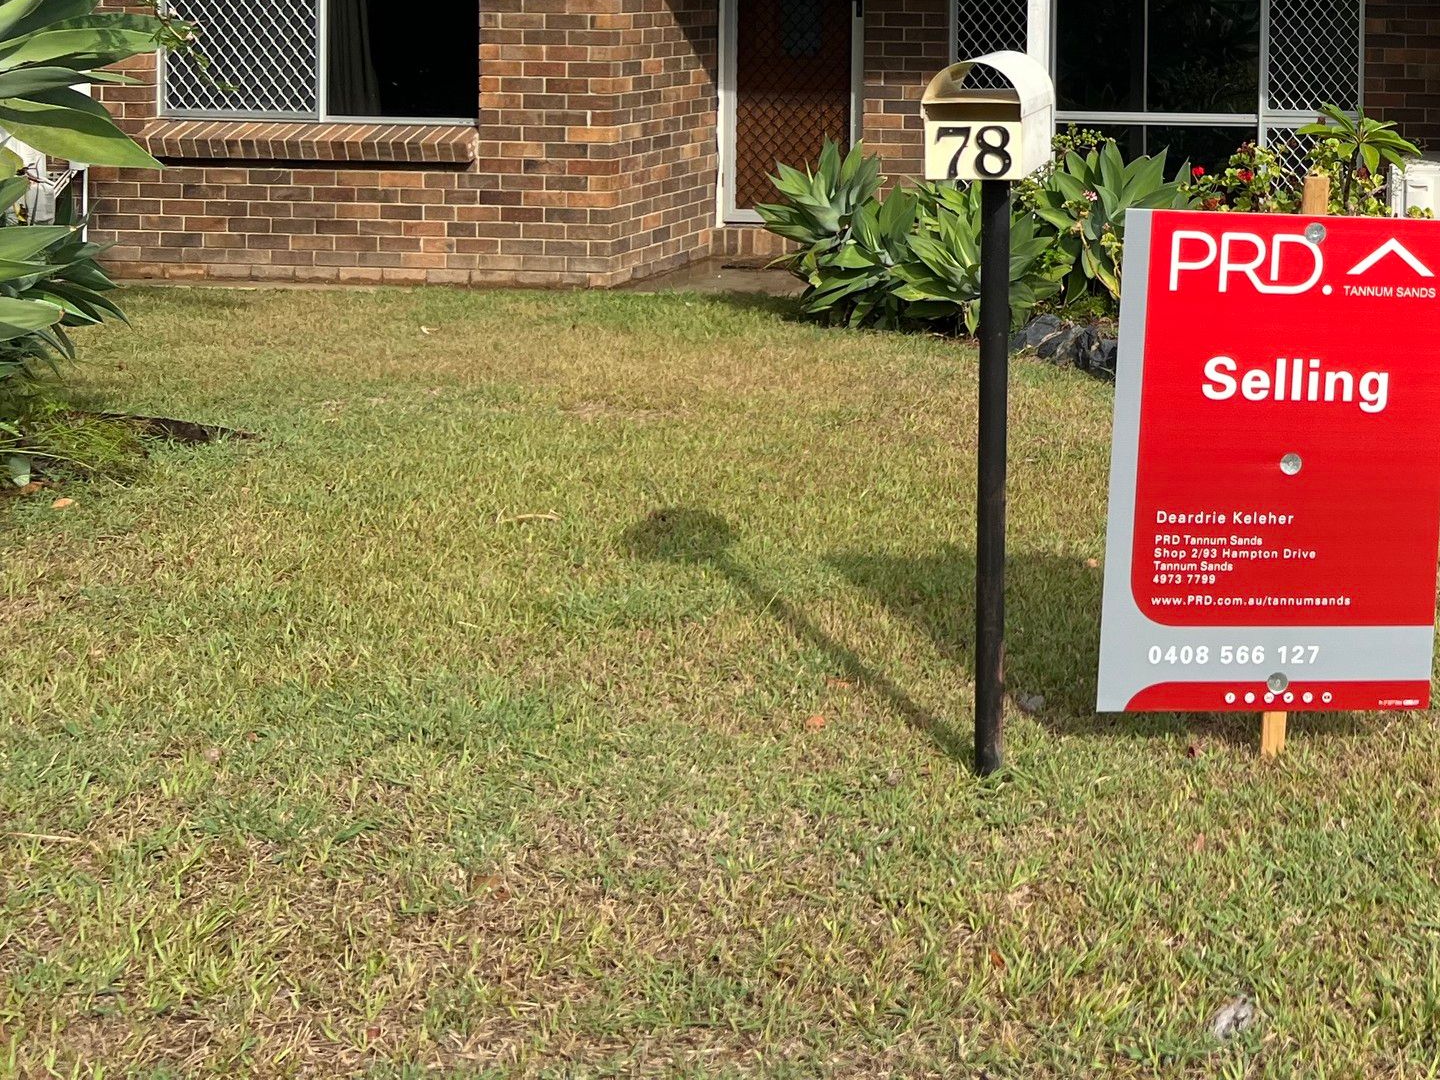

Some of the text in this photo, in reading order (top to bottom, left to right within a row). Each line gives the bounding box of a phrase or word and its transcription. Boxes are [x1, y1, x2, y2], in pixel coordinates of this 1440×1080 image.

[935, 125, 1012, 179] 78
[1343, 285, 1436, 299] TANNUM SANDS
[1201, 355, 1389, 413] Selling
[1156, 510, 1294, 525] Deardrie Keleher
[1155, 534, 1263, 546] PRD Tannum Sands
[1153, 548, 1316, 561] Shop 2/93 Hampton Drive
[1153, 561, 1233, 572] Tannum Sands
[1152, 574, 1216, 585] 4973 7799
[1151, 594, 1351, 607] www.PRD.com.au/tannumsands
[1148, 645, 1320, 665] 0408 566 127
